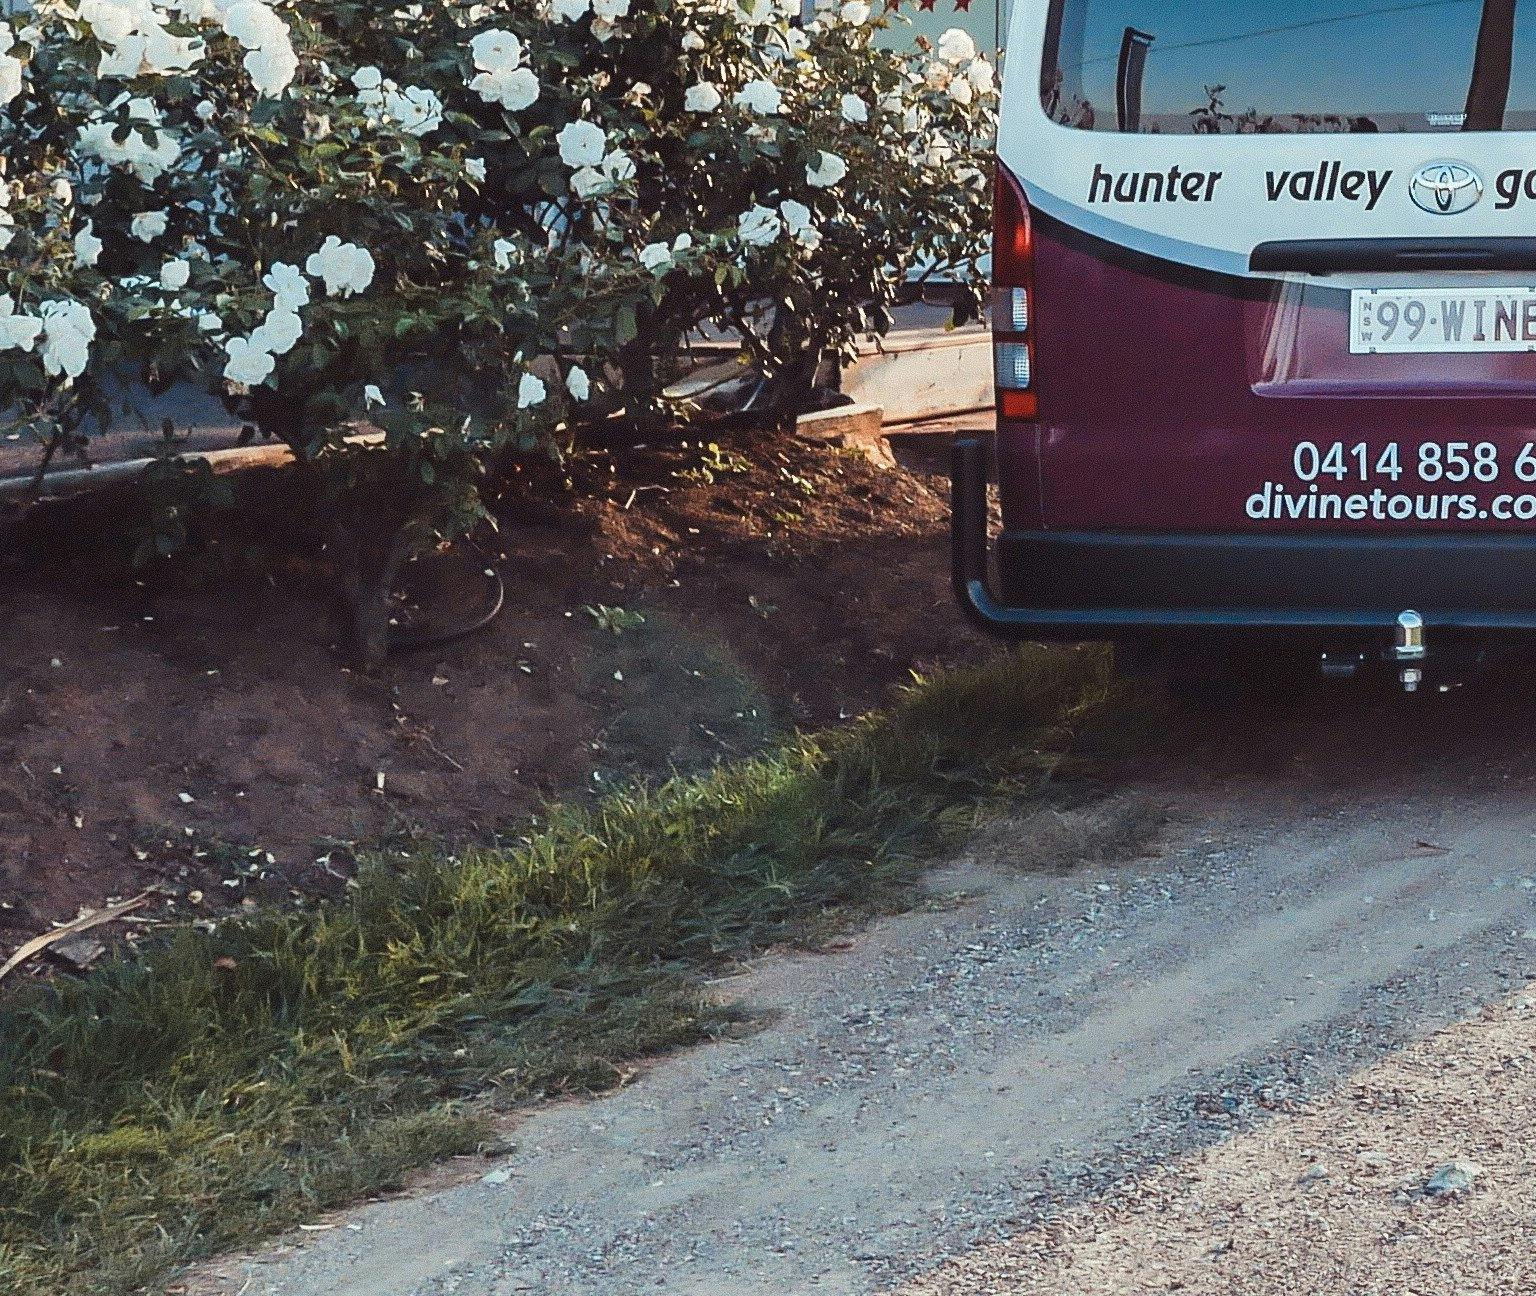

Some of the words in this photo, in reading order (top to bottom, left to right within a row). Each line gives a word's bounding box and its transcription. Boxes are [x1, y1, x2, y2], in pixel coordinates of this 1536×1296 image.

[1087, 163, 1223, 203] hunter
[1265, 160, 1394, 211] valley
[1293, 441, 1403, 481] 0414
[1417, 441, 1499, 482] 858
